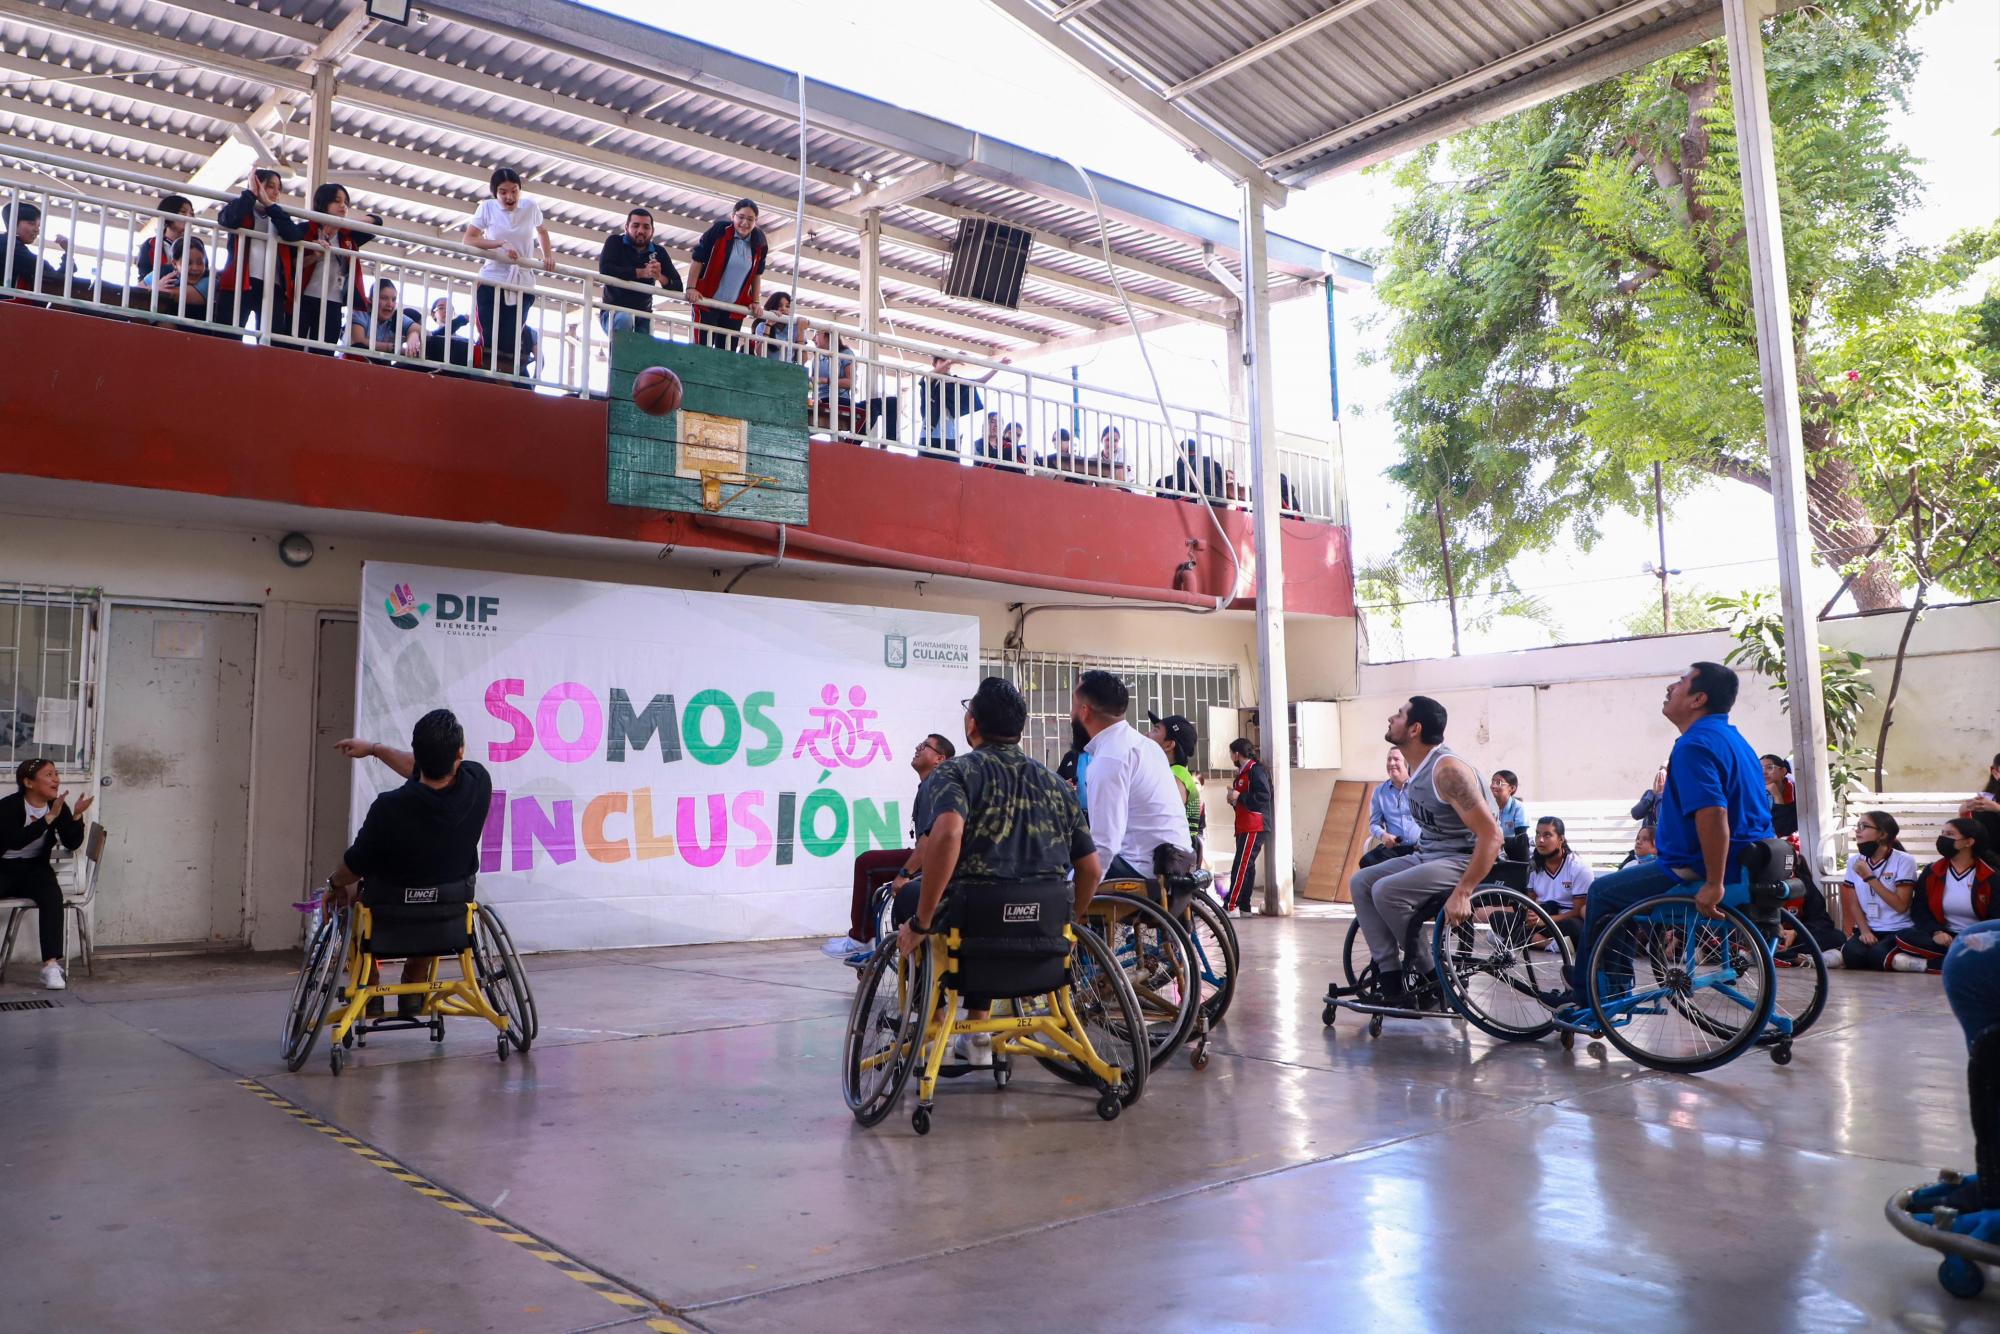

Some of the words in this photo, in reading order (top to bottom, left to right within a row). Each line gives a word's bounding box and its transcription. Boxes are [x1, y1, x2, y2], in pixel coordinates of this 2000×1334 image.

[436, 593, 500, 622] DIF
[435, 622, 498, 631] BIENESTAR
[912, 641, 958, 650] AYUNTAMIENTO
[485, 678, 783, 767] SOMOS
[480, 769, 902, 873] INCLUSIÓN
[408, 890, 435, 898] LINCE
[1007, 905, 1037, 915] LINCE
[1016, 1017, 1032, 1027] 2EZ
